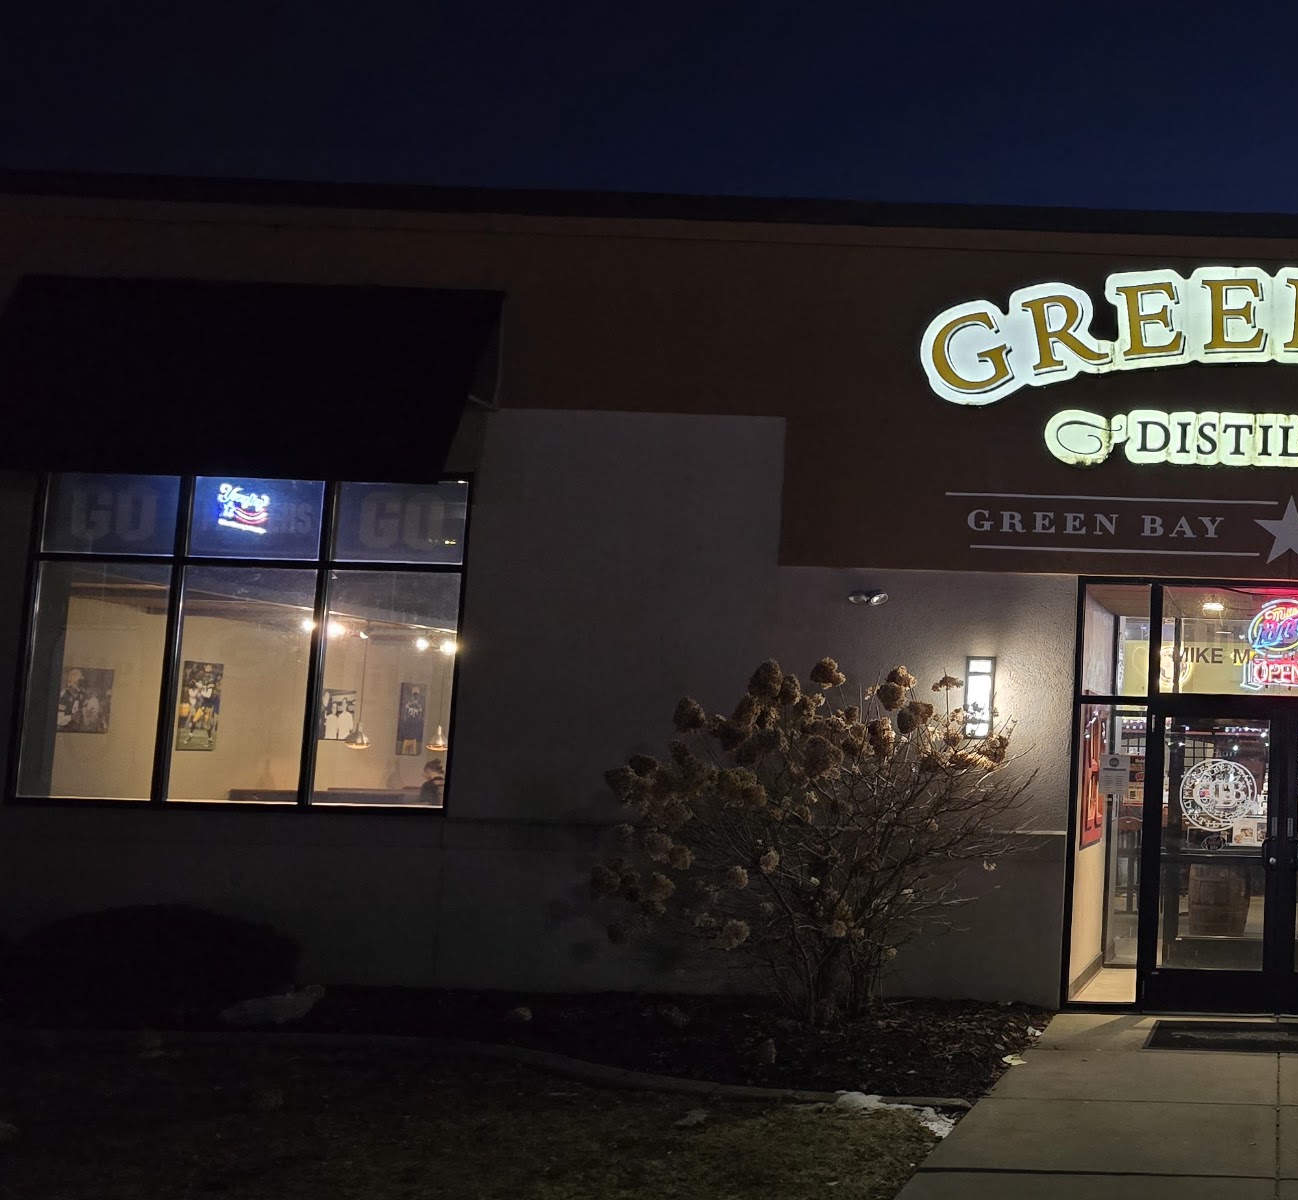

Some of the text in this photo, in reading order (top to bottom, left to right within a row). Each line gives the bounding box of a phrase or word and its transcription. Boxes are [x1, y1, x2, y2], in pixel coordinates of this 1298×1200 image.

[70, 485, 158, 542] GO
[358, 489, 447, 549] GO
[966, 508, 1121, 540] GREEN
[1141, 513, 1225, 541] BAY
[1173, 647, 1223, 664] MIKE
